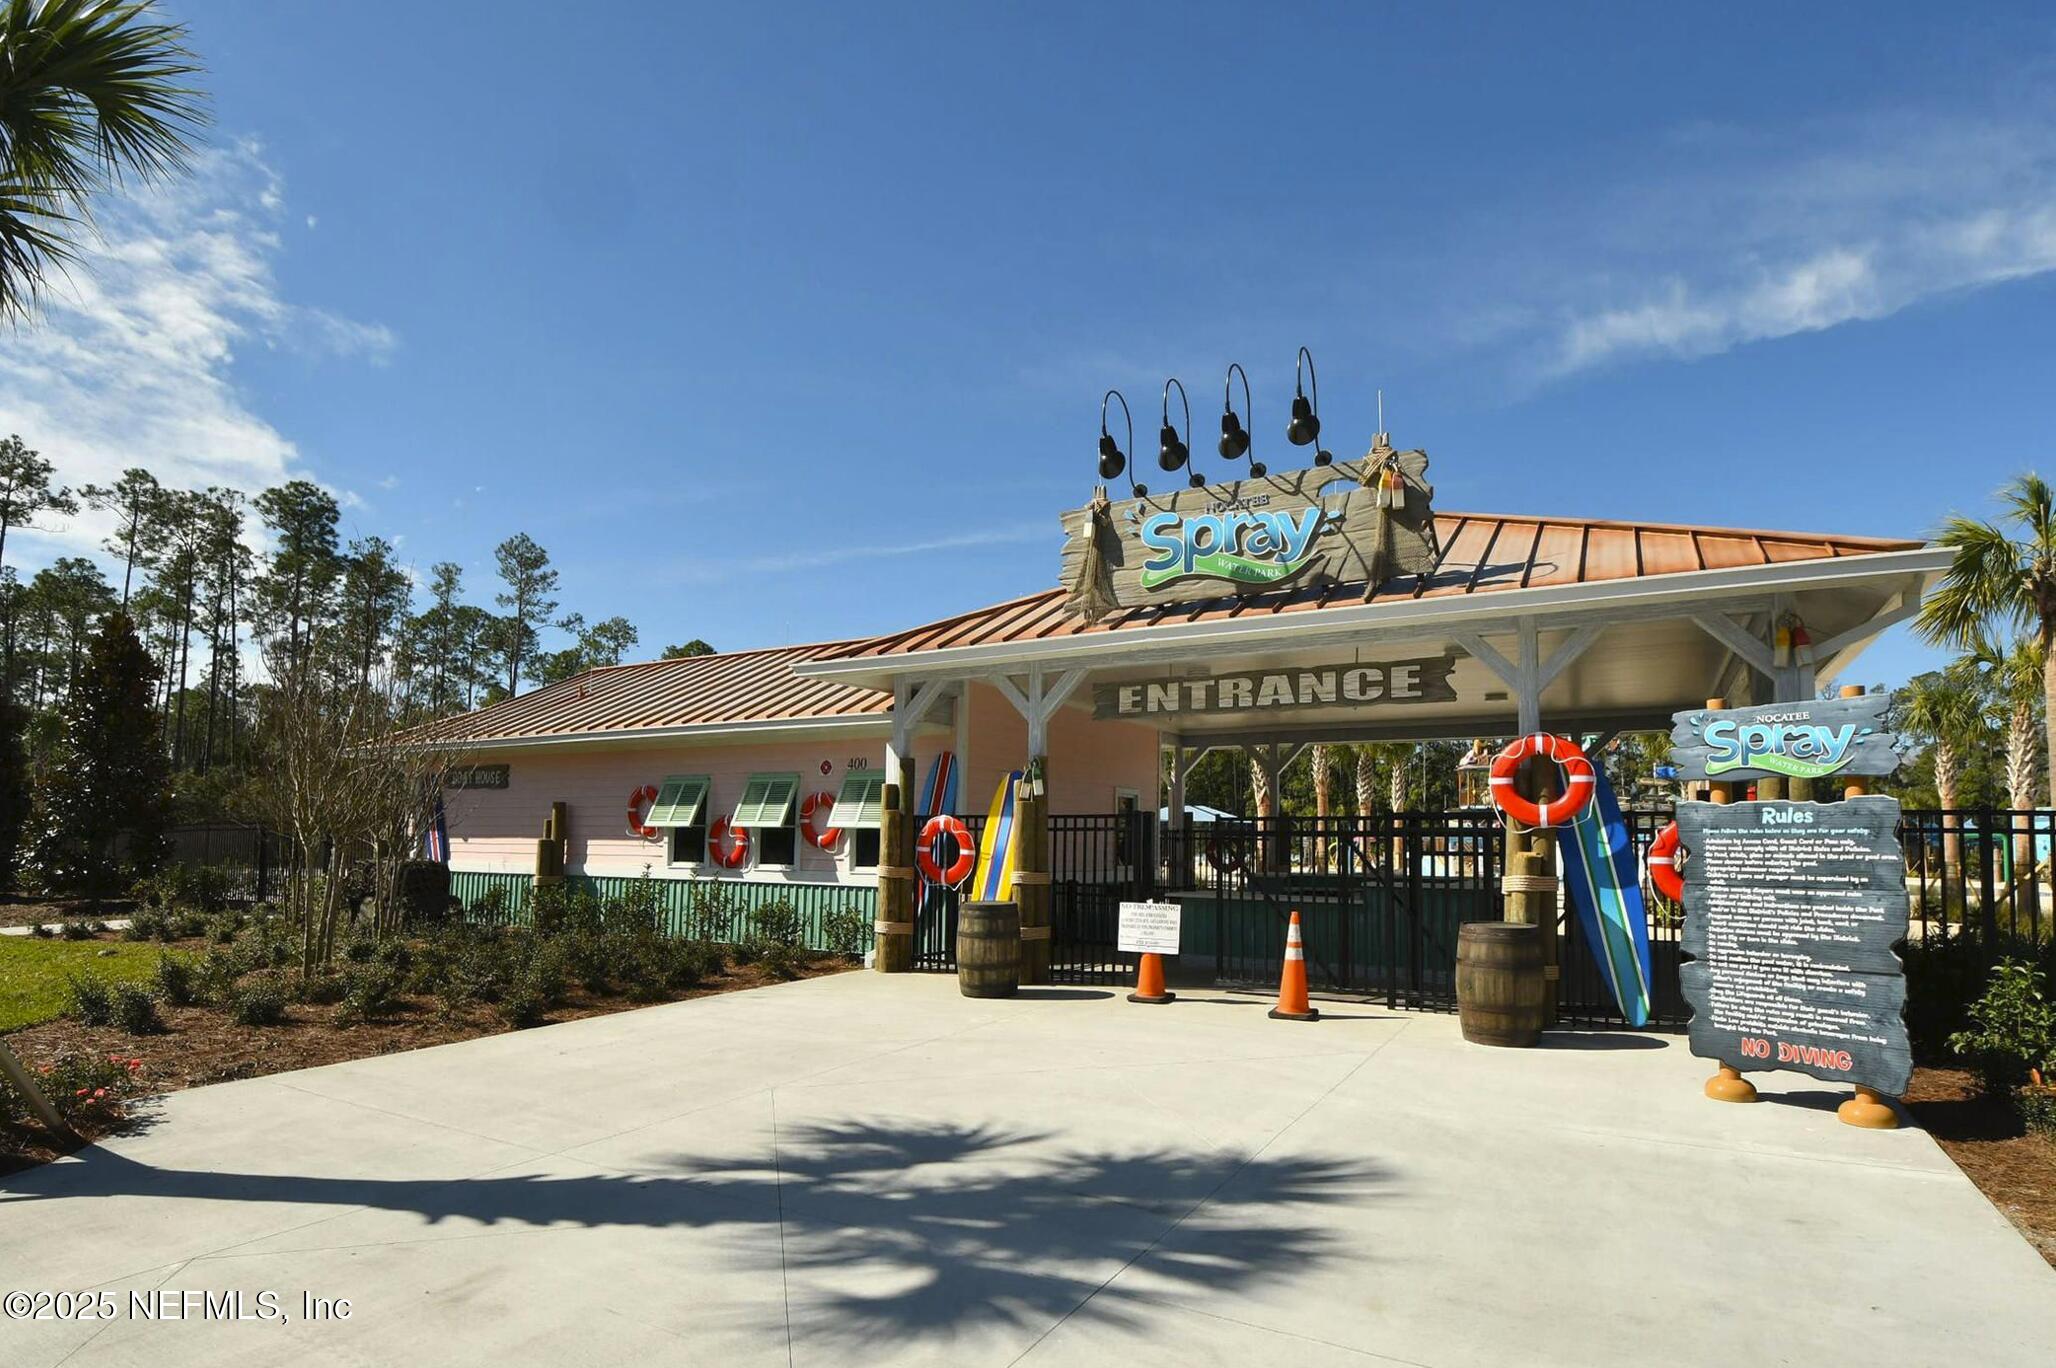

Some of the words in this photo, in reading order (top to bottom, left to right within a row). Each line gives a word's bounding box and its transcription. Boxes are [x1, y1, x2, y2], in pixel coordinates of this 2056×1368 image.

[1141, 506, 1327, 573] Spray
[1218, 557, 1251, 576] WATER
[1255, 564, 1282, 577] PARK
[1118, 664, 1423, 714] ENTRANCE
[1755, 711, 1811, 724] NOCATEE
[1704, 720, 1856, 766] Spray
[848, 757, 867, 770] 400
[1800, 766, 1824, 775] PARK
[475, 770, 502, 785] HOUSE
[1761, 807, 1814, 825] Rules
[1741, 1037, 1770, 1059] NO
[1777, 1041, 1853, 1071] DIVING
